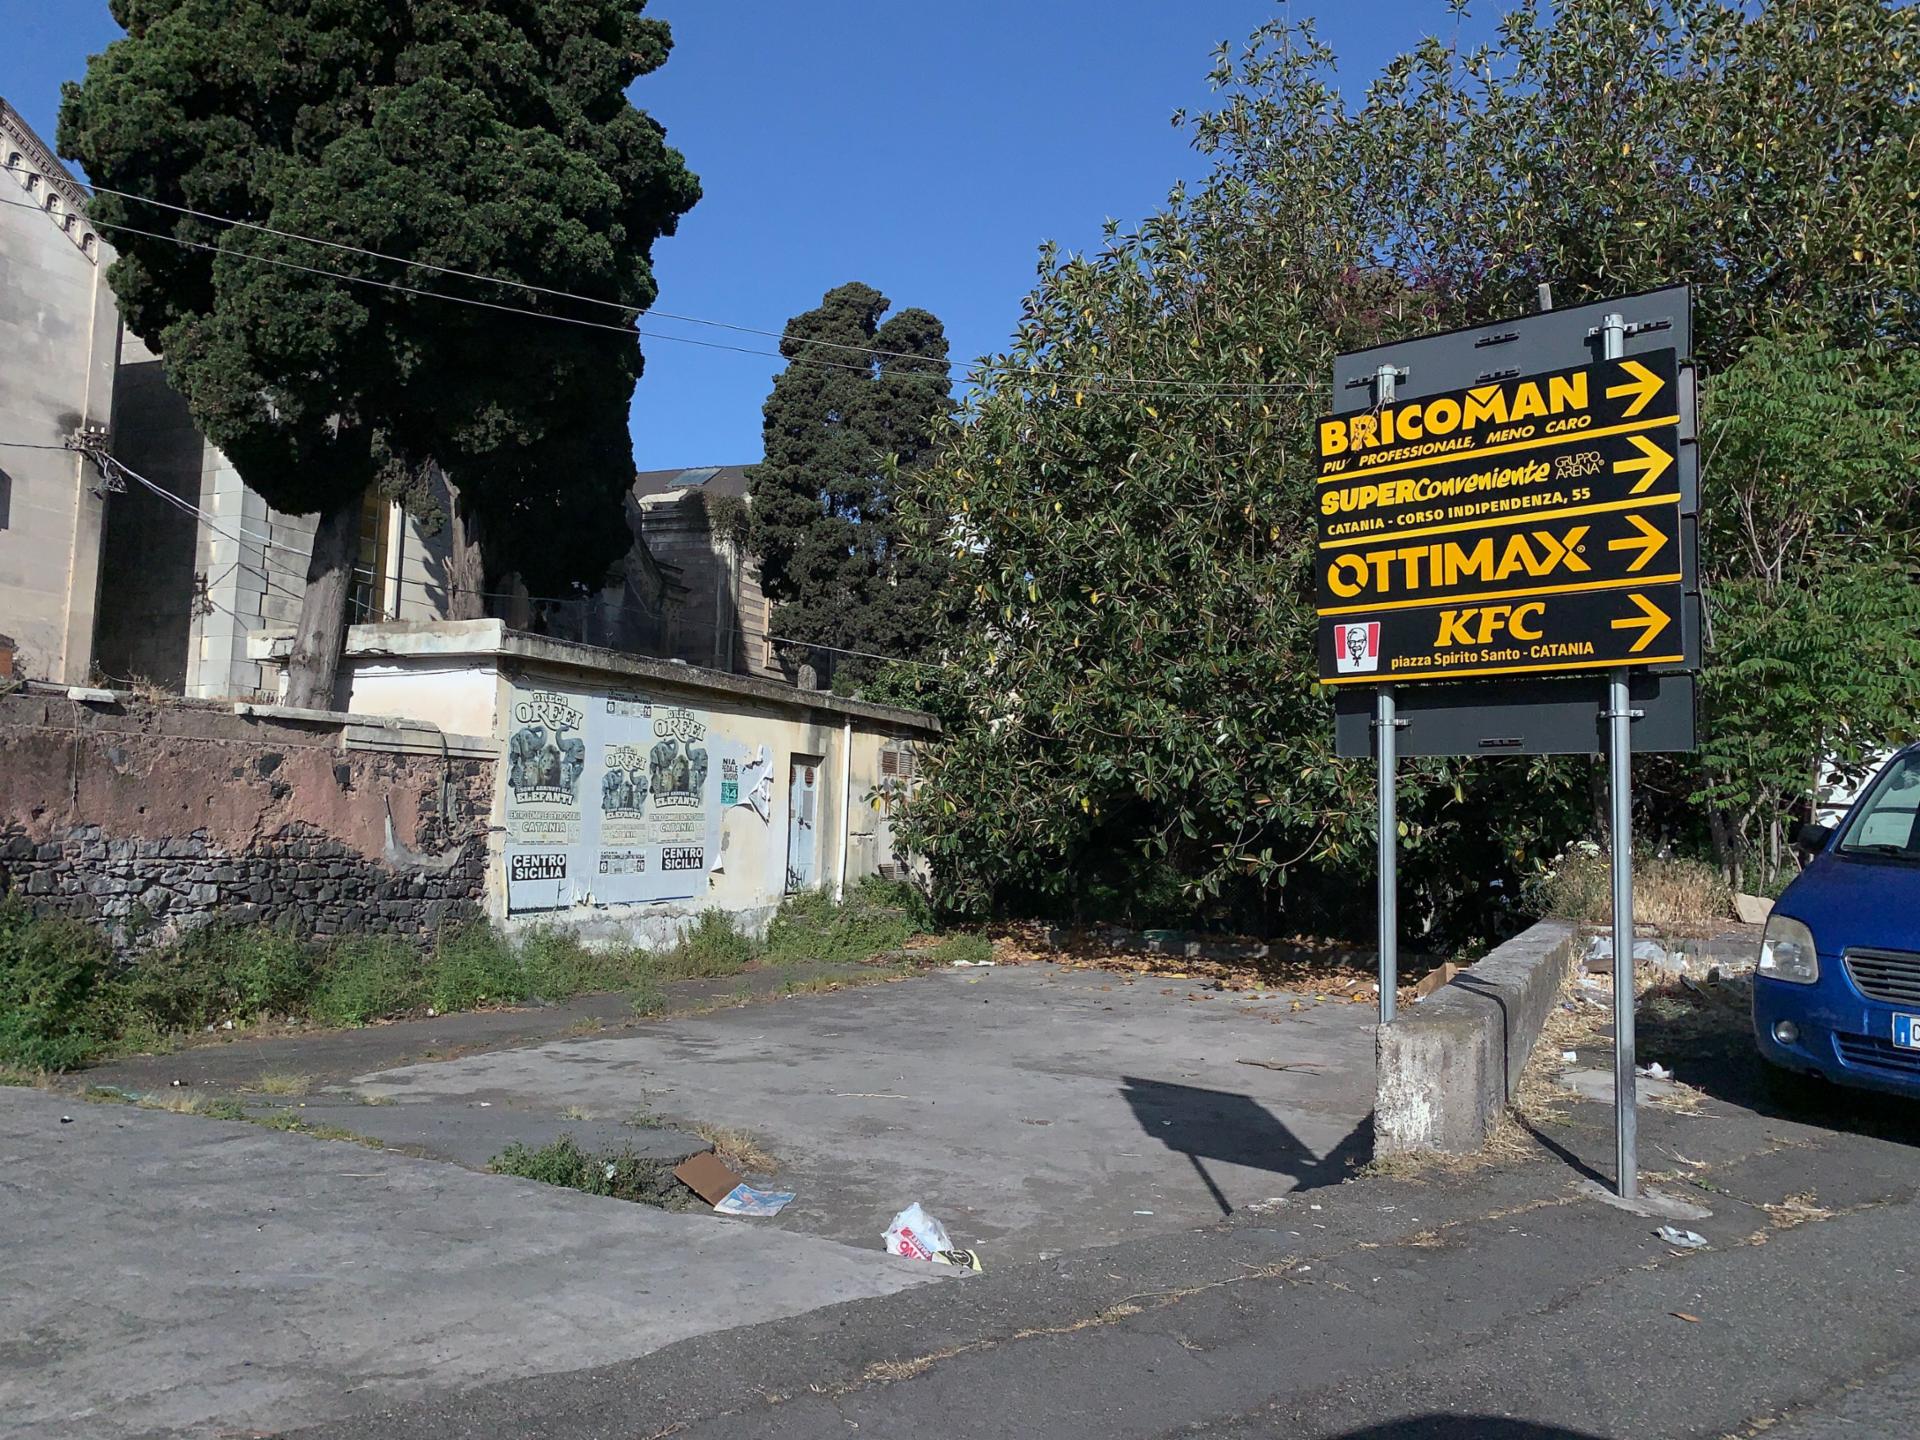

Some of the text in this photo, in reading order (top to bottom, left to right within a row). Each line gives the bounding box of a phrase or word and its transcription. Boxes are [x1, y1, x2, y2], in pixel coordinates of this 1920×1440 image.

[1320, 371, 1589, 456] BRICOMAN
[1358, 436, 1476, 467] PROFESSIONALE,
[1486, 425, 1536, 444] MENO
[1545, 415, 1592, 434] CARO
[1554, 451, 1601, 468] GRUPPO
[1555, 463, 1600, 480] ARENA
[1327, 518, 1385, 536] CATANIA
[1397, 509, 1444, 526] CORSO
[1448, 491, 1568, 518] INDIPENDENZA,
[1572, 487, 1591, 501] 55
[1327, 525, 1592, 598] OTTIMAX
[1433, 602, 1546, 647] KFC
[1391, 655, 1432, 671] piazza
[1434, 650, 1478, 667] Spirito
[1480, 647, 1520, 662] Santo
[1530, 641, 1595, 659] CATANIA
[515, 790, 574, 805] ELEFANTI
[655, 796, 700, 808] ELEFANTI
[522, 822, 566, 832] CATANIA
[513, 854, 566, 867] CENTRO
[663, 848, 703, 859] CENTRO
[665, 858, 701, 869] SICILIA
[515, 867, 563, 879] SICILIA
